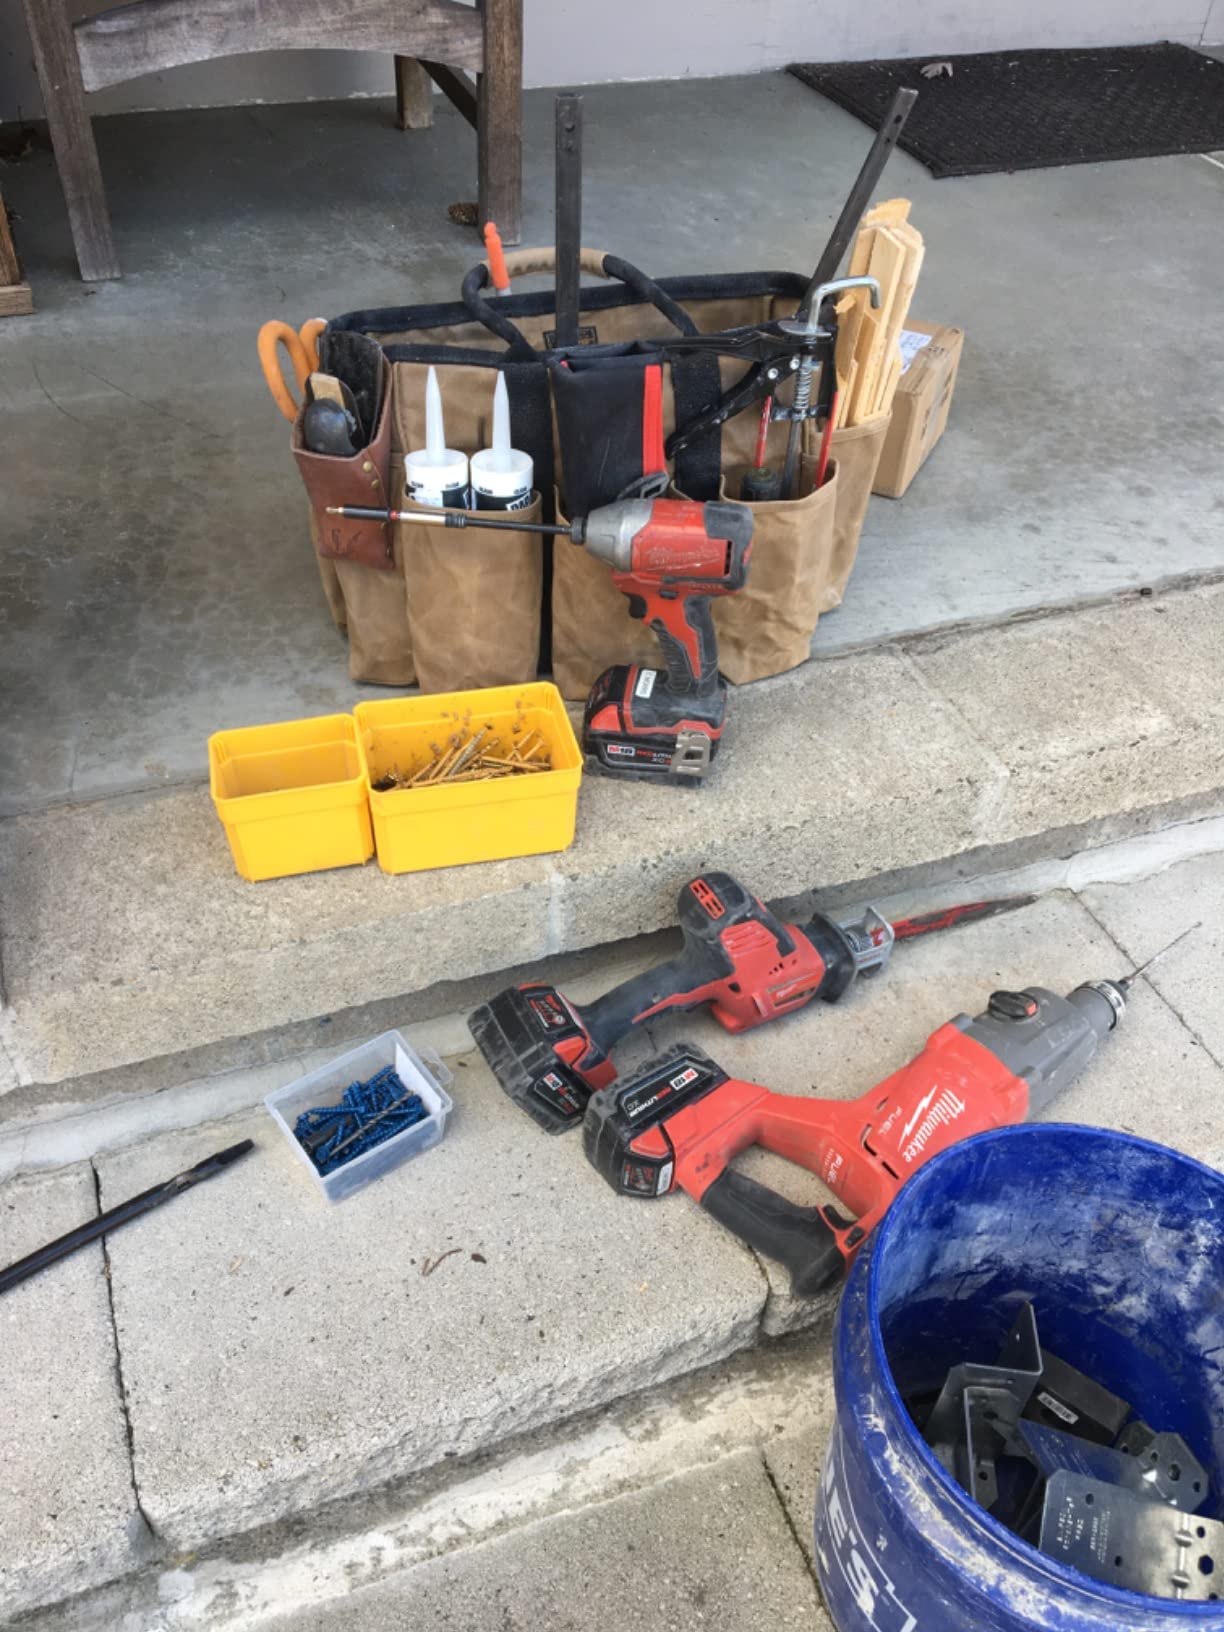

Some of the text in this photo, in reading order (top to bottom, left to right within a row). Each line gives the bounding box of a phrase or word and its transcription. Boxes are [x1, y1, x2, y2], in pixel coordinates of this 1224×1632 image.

[877, 1105, 903, 1135] FUEL
[902, 1088, 966, 1163] Milwaukee
[827, 1153, 843, 1184] FUEL
